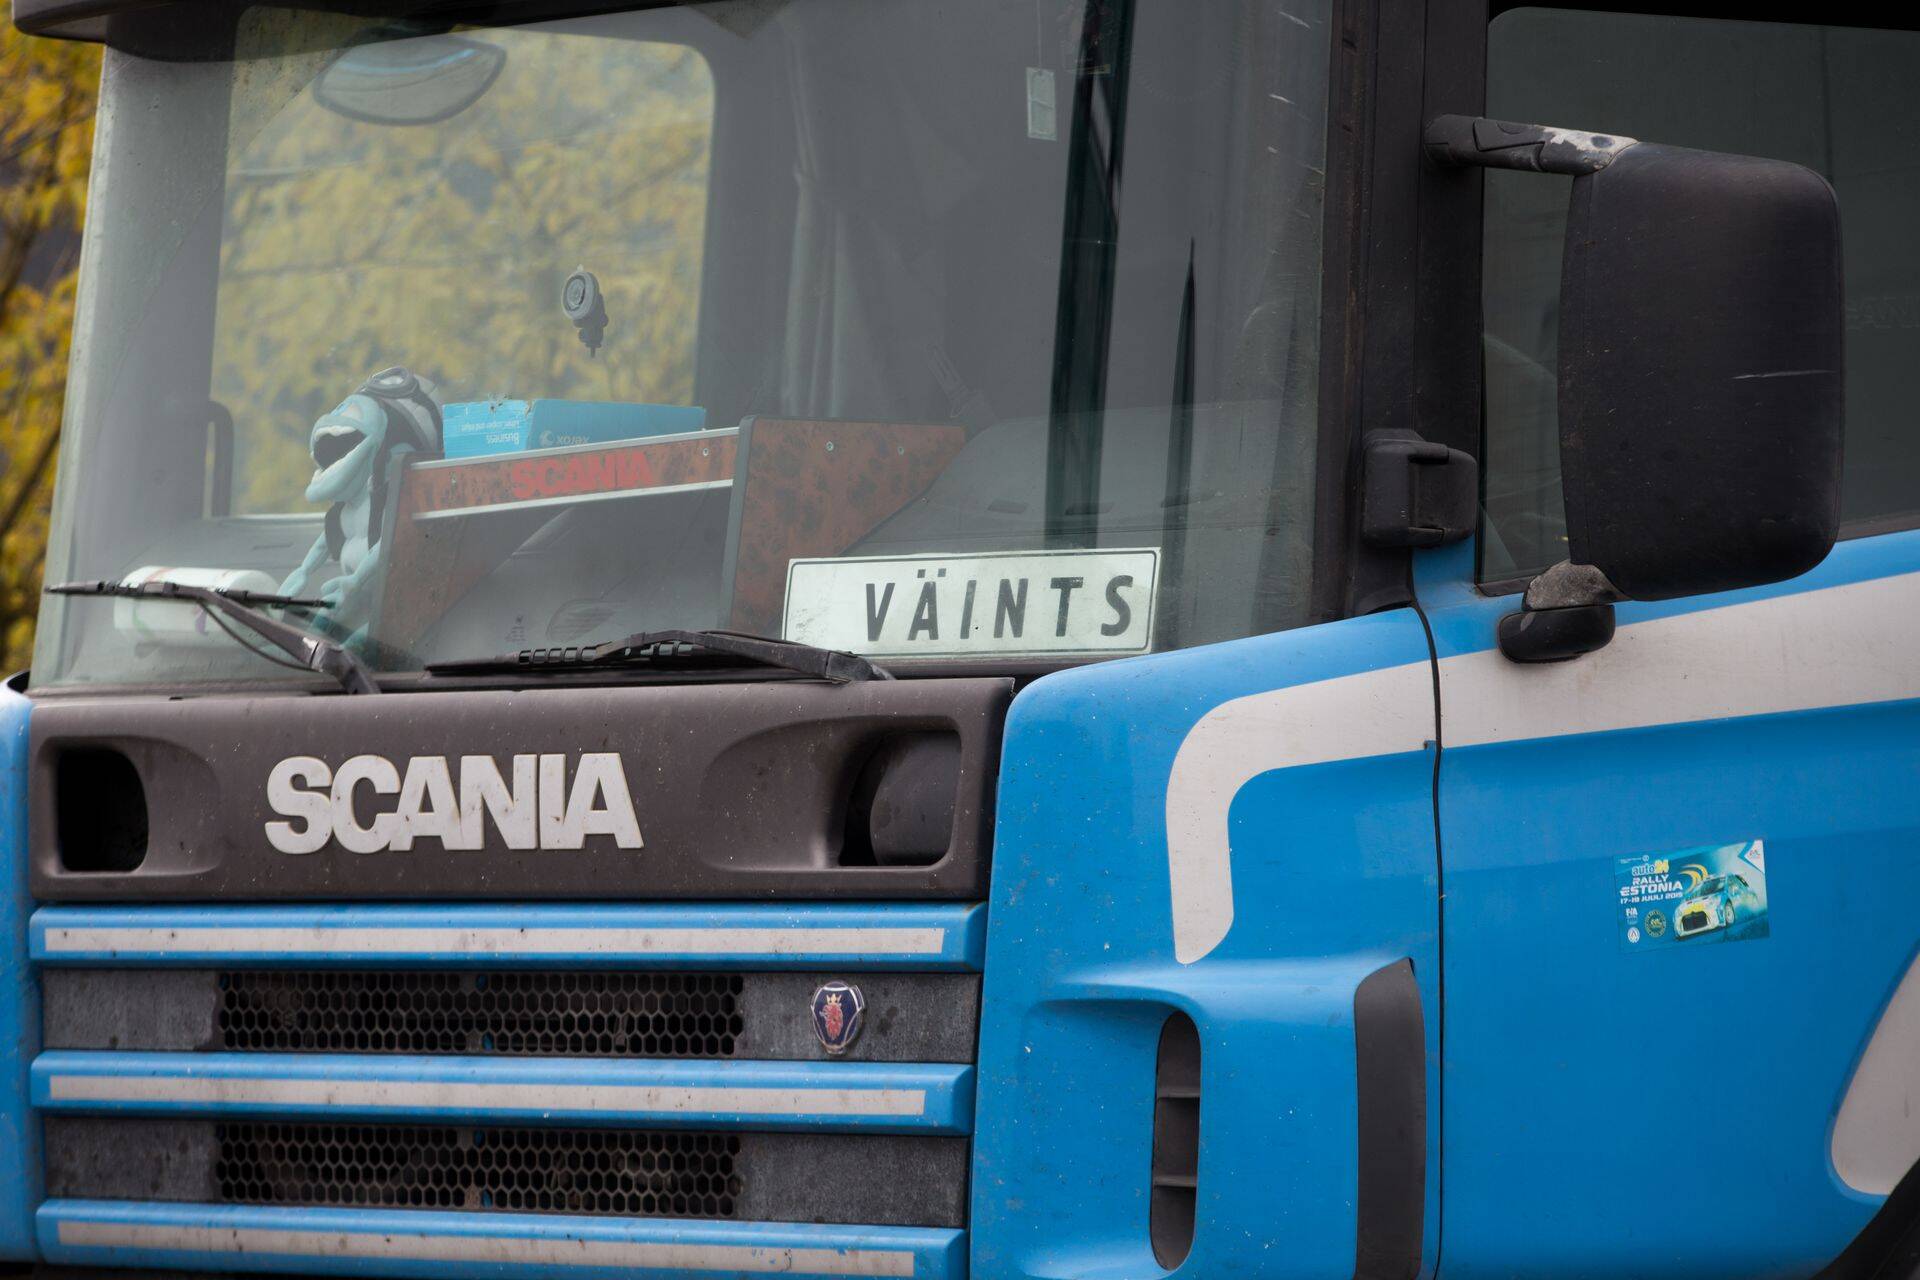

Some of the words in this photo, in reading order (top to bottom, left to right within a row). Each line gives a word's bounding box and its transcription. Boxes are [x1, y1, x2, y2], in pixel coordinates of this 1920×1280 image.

[486, 432, 520, 445] Business
[511, 450, 653, 499] SCANIA
[865, 567, 1134, 642] VÄINTS
[264, 752, 645, 855] SCANIA
[1620, 881, 1684, 897] ESTONIA
[1632, 874, 1669, 886] RALLY
